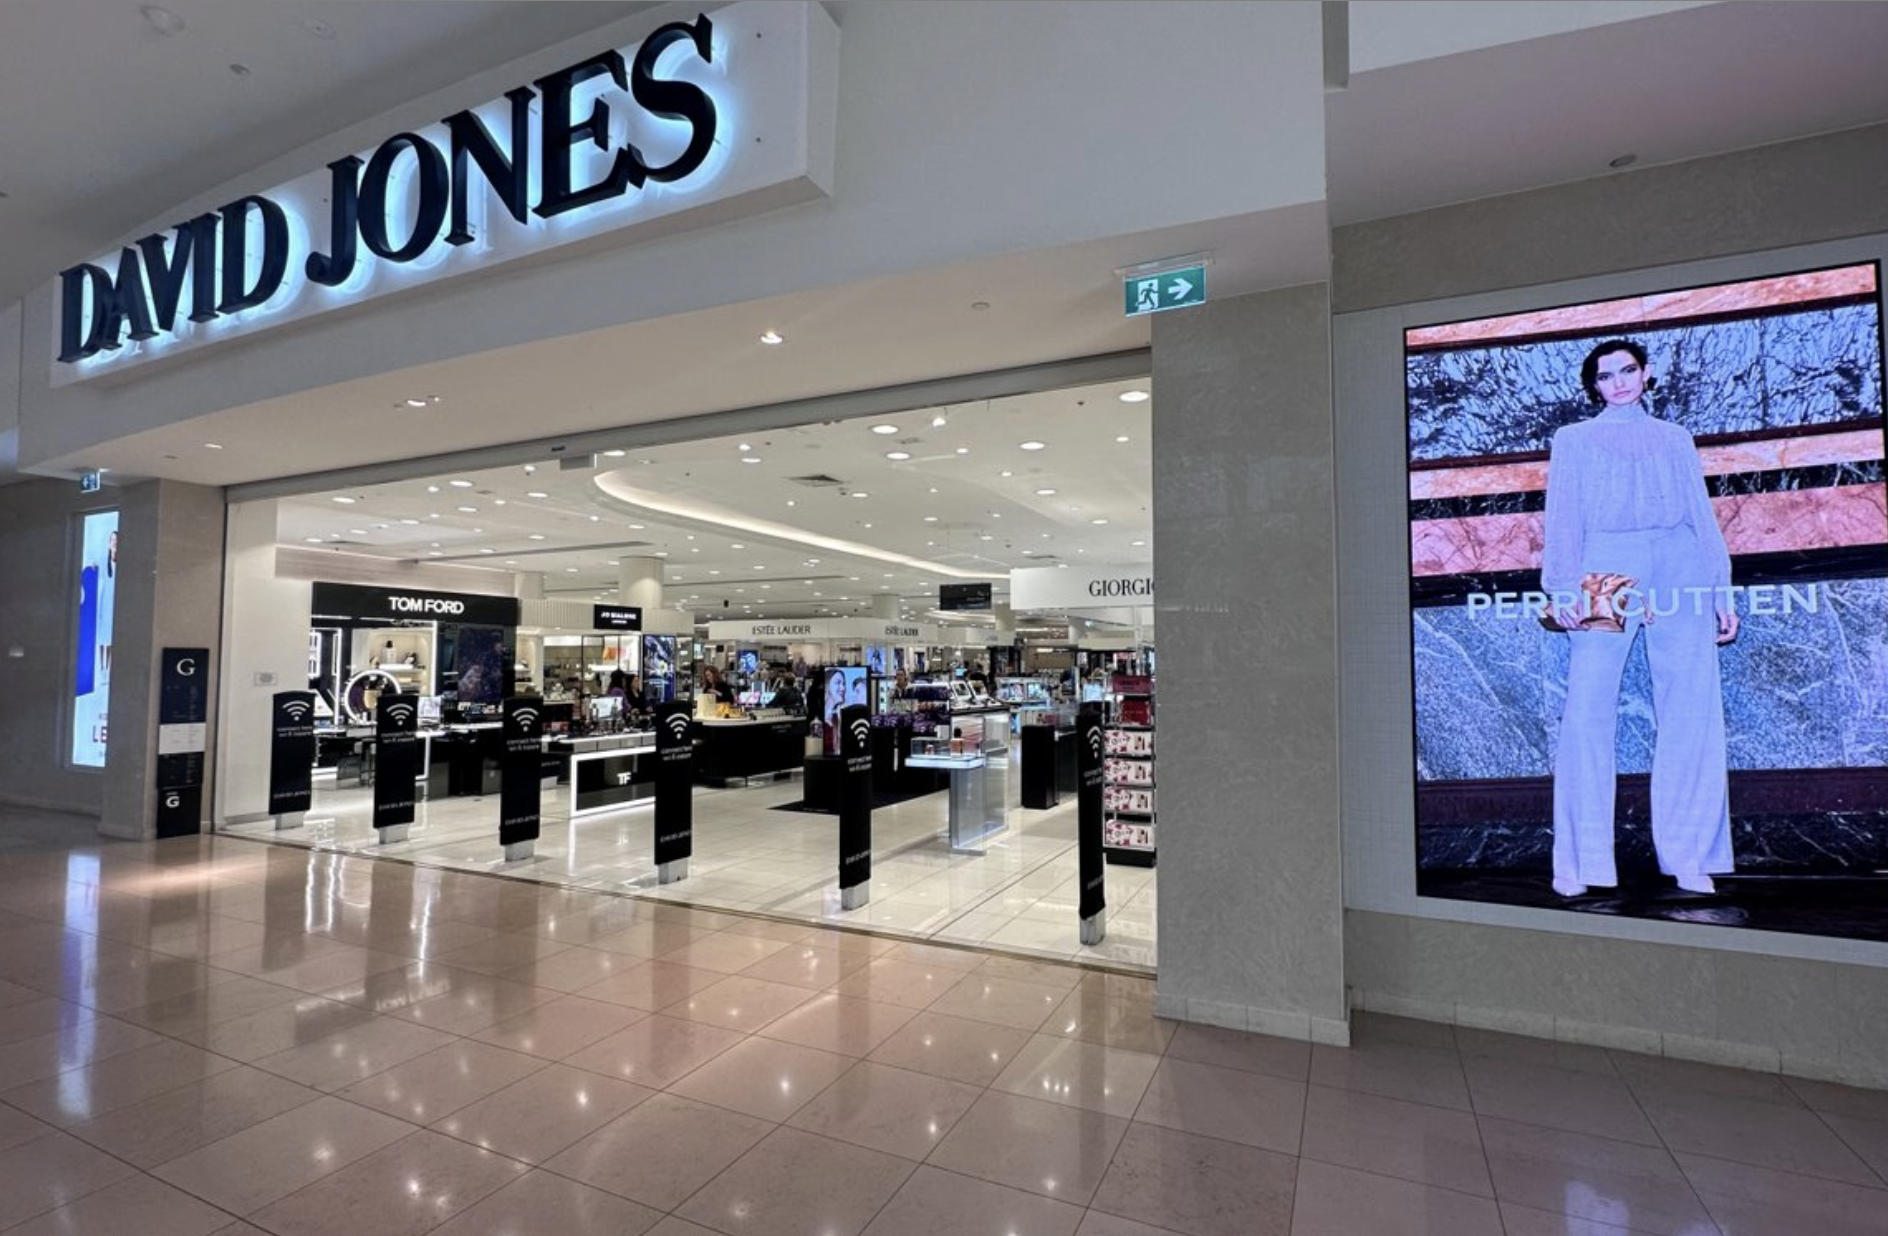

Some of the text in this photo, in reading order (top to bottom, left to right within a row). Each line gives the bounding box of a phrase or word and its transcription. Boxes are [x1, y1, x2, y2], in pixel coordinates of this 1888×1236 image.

[57, 13, 717, 364] DAVID JONES
[1089, 578, 1155, 597] GIORGI
[388, 596, 465, 615] TOM FORD
[1467, 584, 1818, 620] PERRI CUTTEN
[176, 658, 196, 676] G
[617, 772, 631, 785] TF
[166, 795, 180, 808] G
